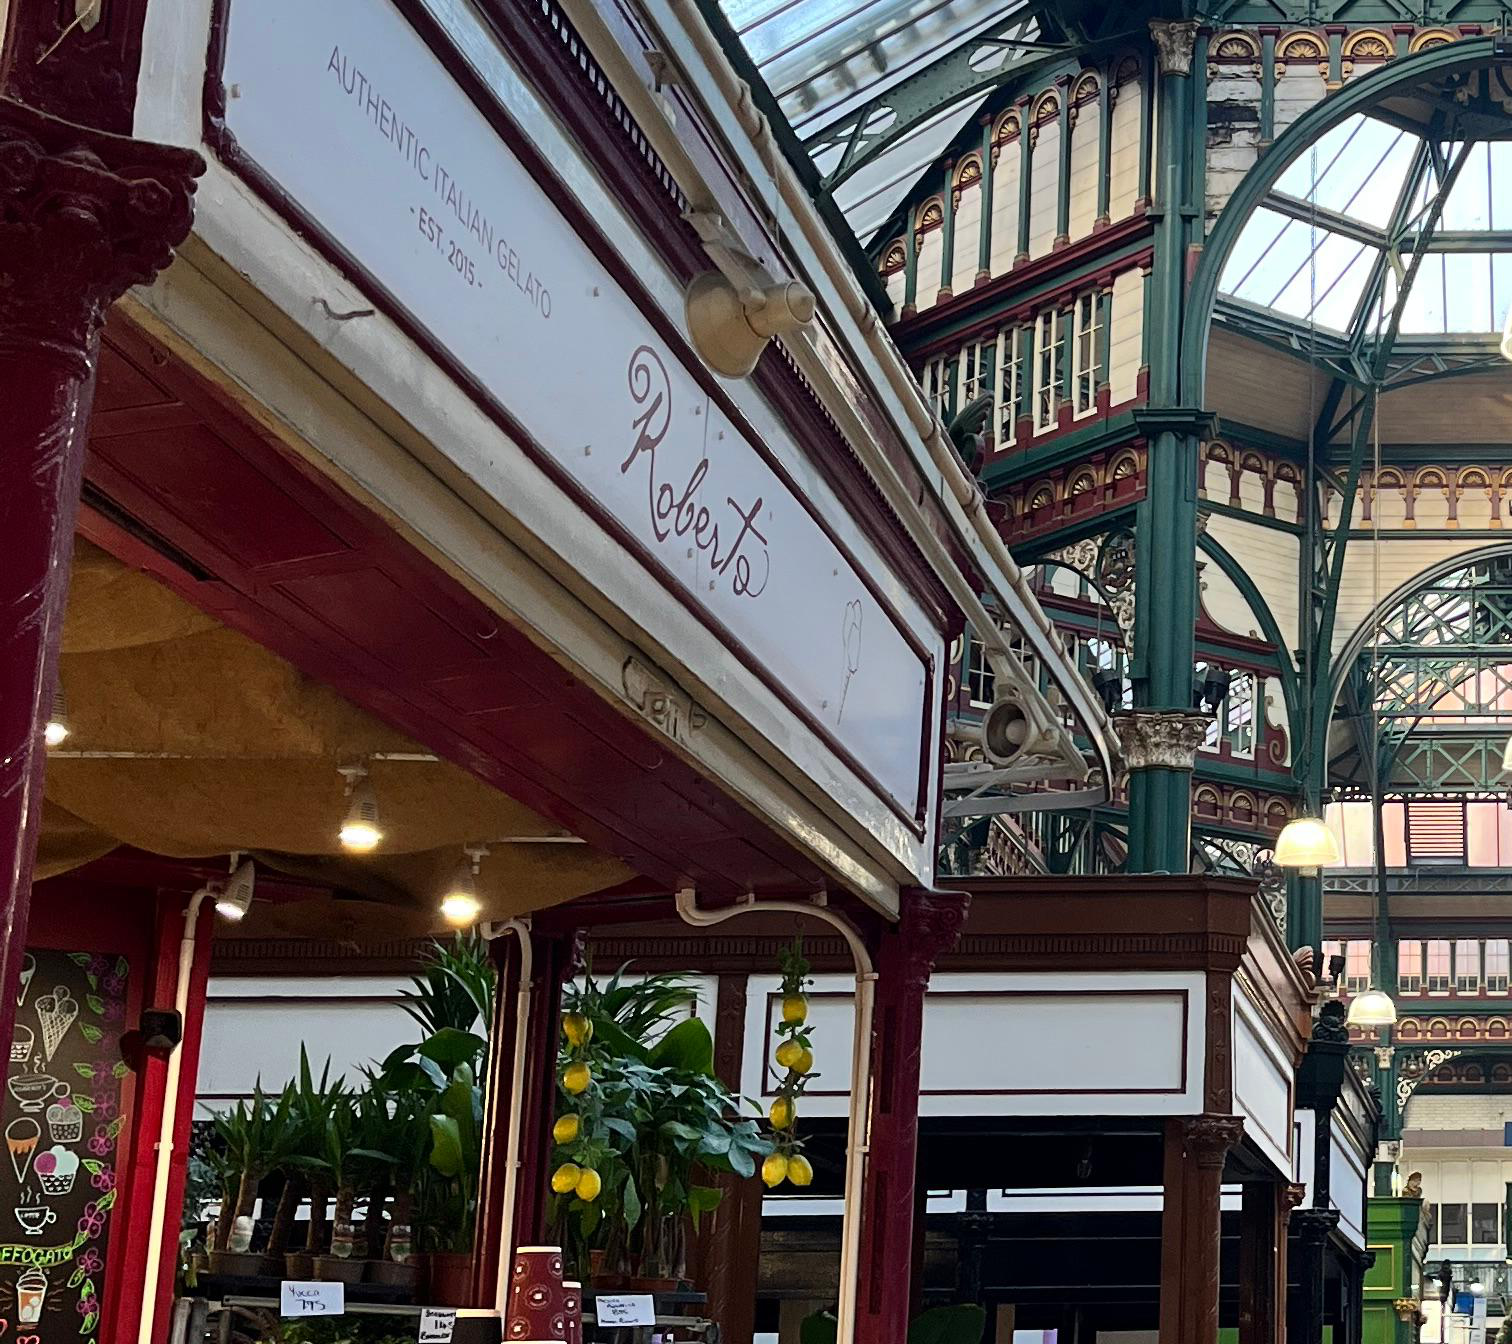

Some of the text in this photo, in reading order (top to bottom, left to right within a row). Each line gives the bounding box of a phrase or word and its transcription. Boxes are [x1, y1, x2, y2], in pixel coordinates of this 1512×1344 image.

[327, 45, 552, 319] AUTHENTIC ITALIAN GELATO
[418, 207, 445, 254] EST.
[447, 240, 475, 287] 2015
[621, 344, 770, 599] Roberto
[0, 1245, 74, 1265] FFOGATO
